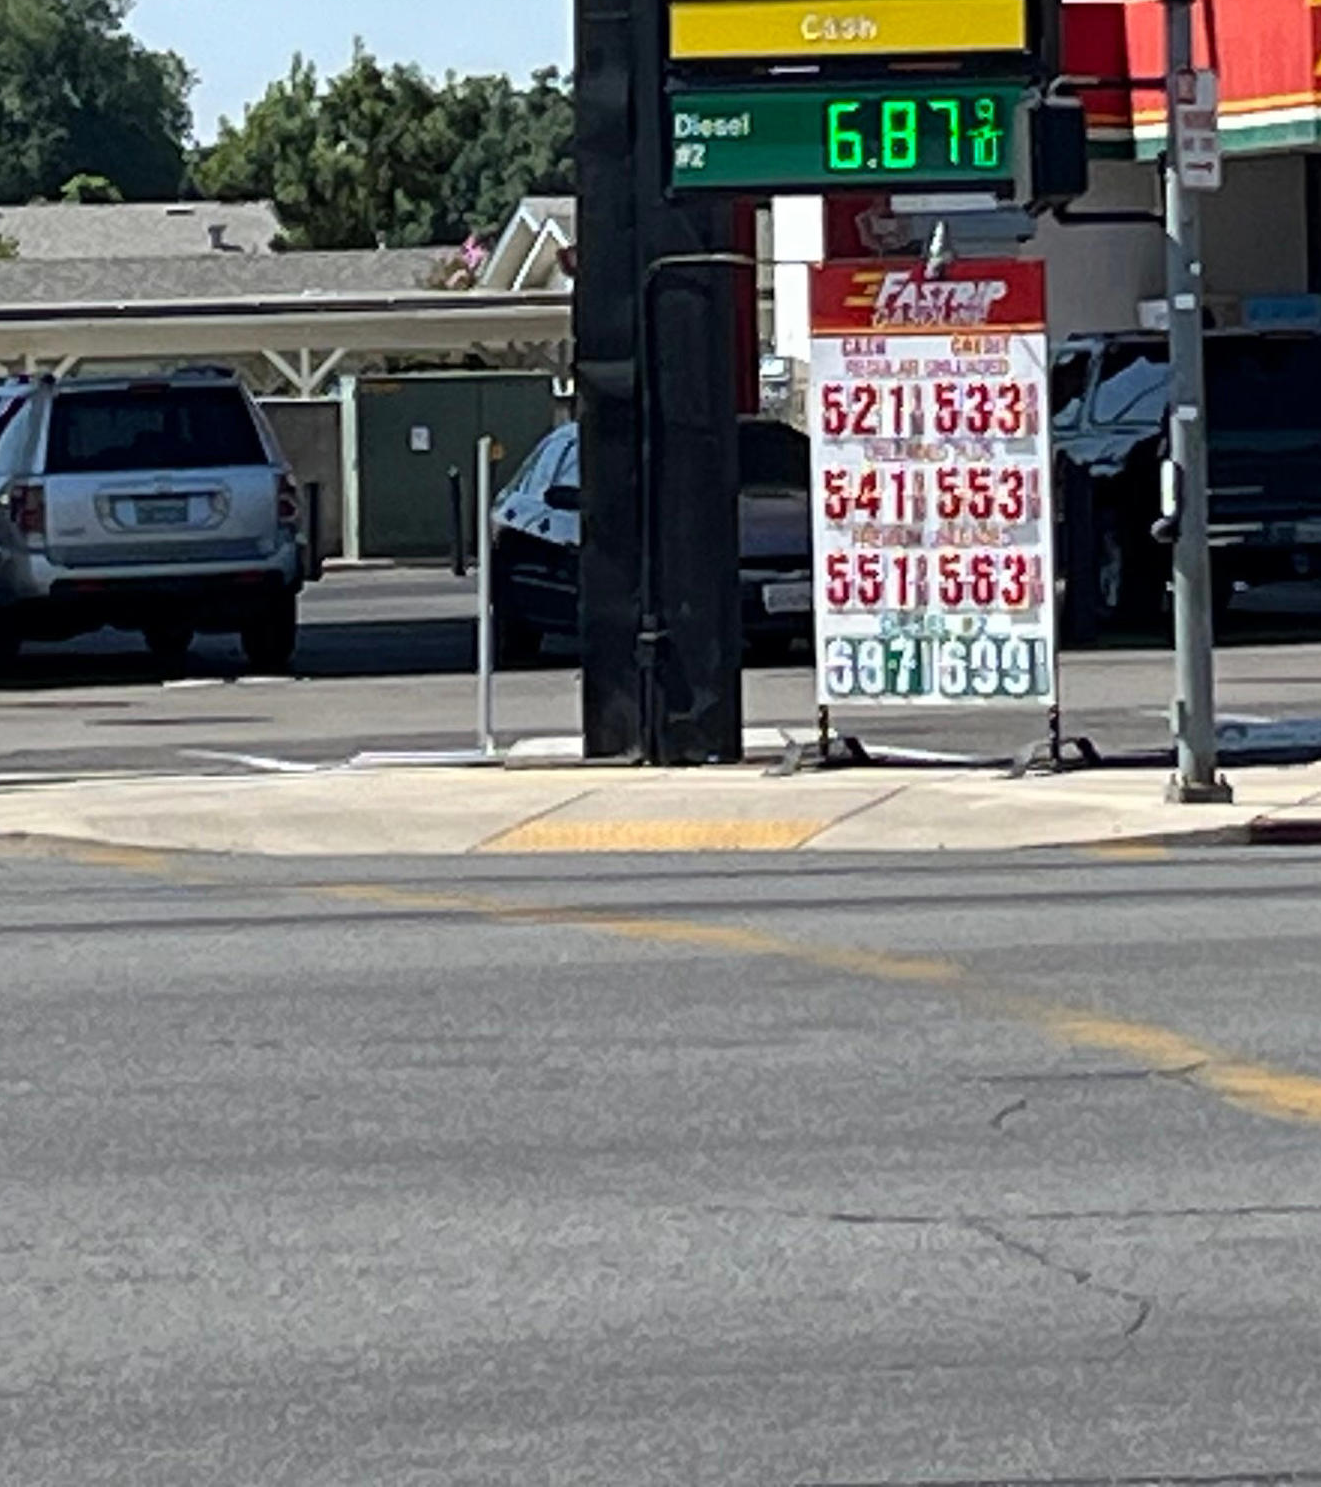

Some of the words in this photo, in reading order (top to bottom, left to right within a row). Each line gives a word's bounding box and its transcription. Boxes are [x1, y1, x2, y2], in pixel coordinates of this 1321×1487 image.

[801, 14, 877, 40] Cash
[675, 113, 750, 139] Diesel
[875, 270, 1008, 315] FASTRIP
